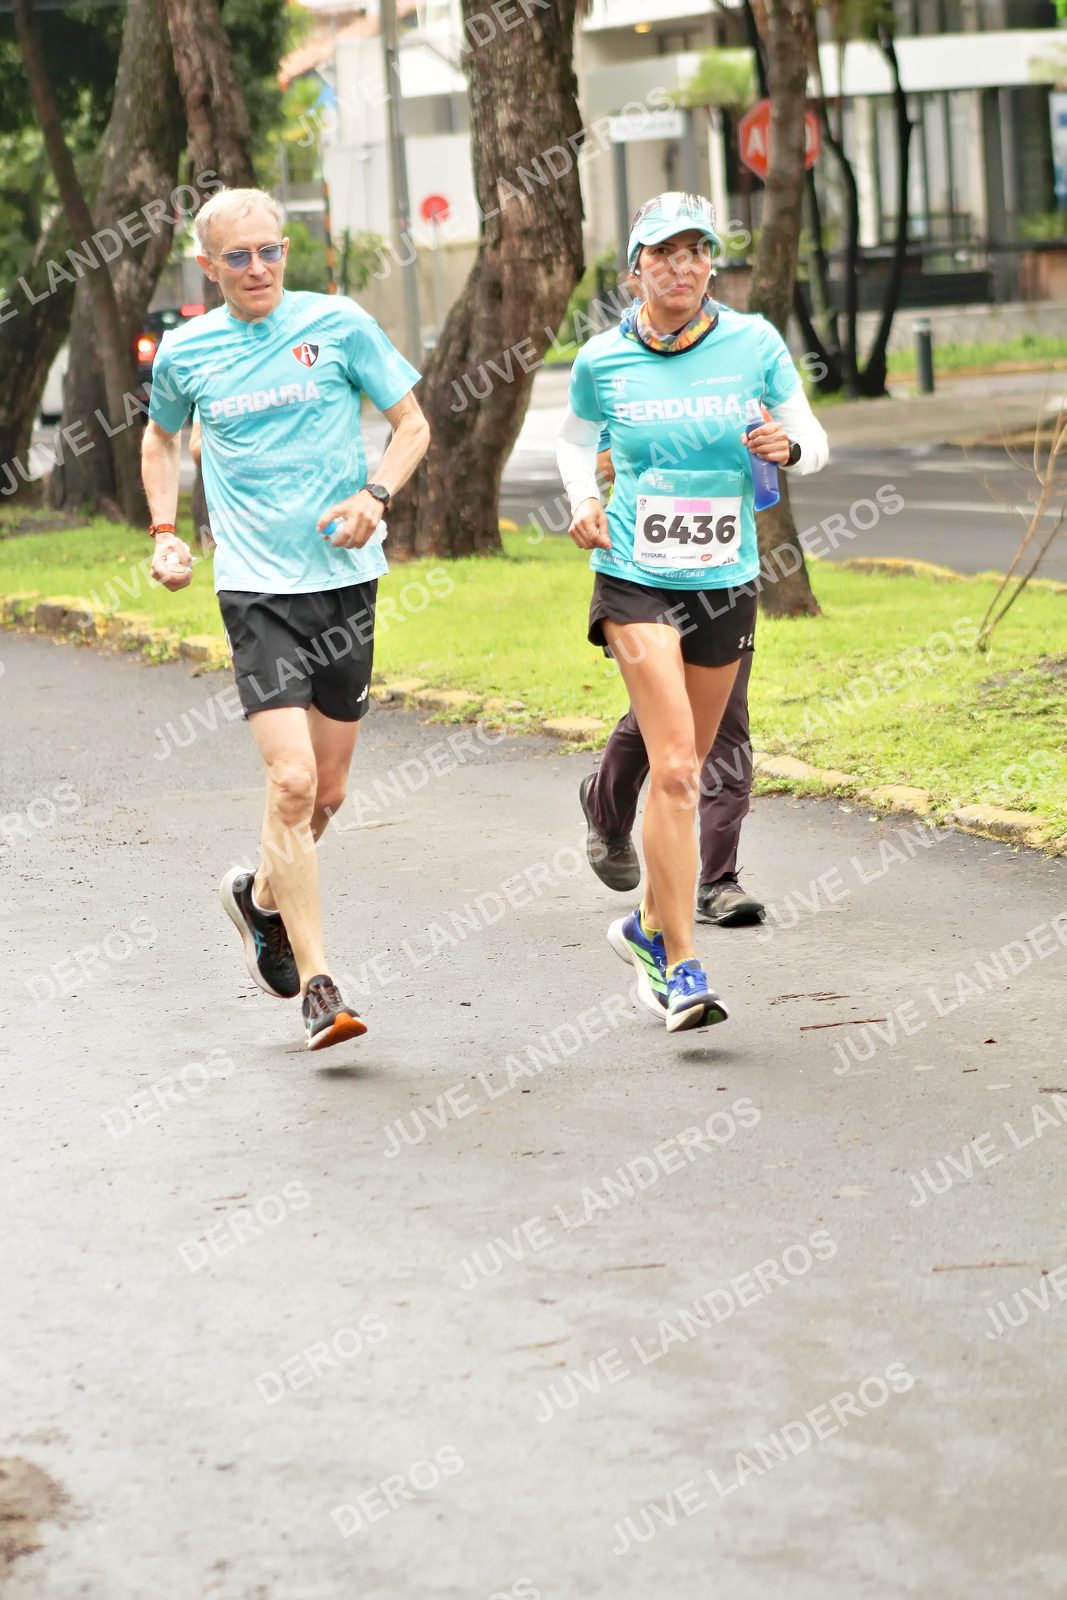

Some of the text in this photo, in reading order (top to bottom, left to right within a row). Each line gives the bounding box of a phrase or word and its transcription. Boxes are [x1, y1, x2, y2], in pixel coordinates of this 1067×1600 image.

[706, 374, 743, 386] BROOKS
[209, 380, 322, 419] PERDURA
[612, 393, 742, 422] PERDURA
[643, 513, 737, 545] 6436
